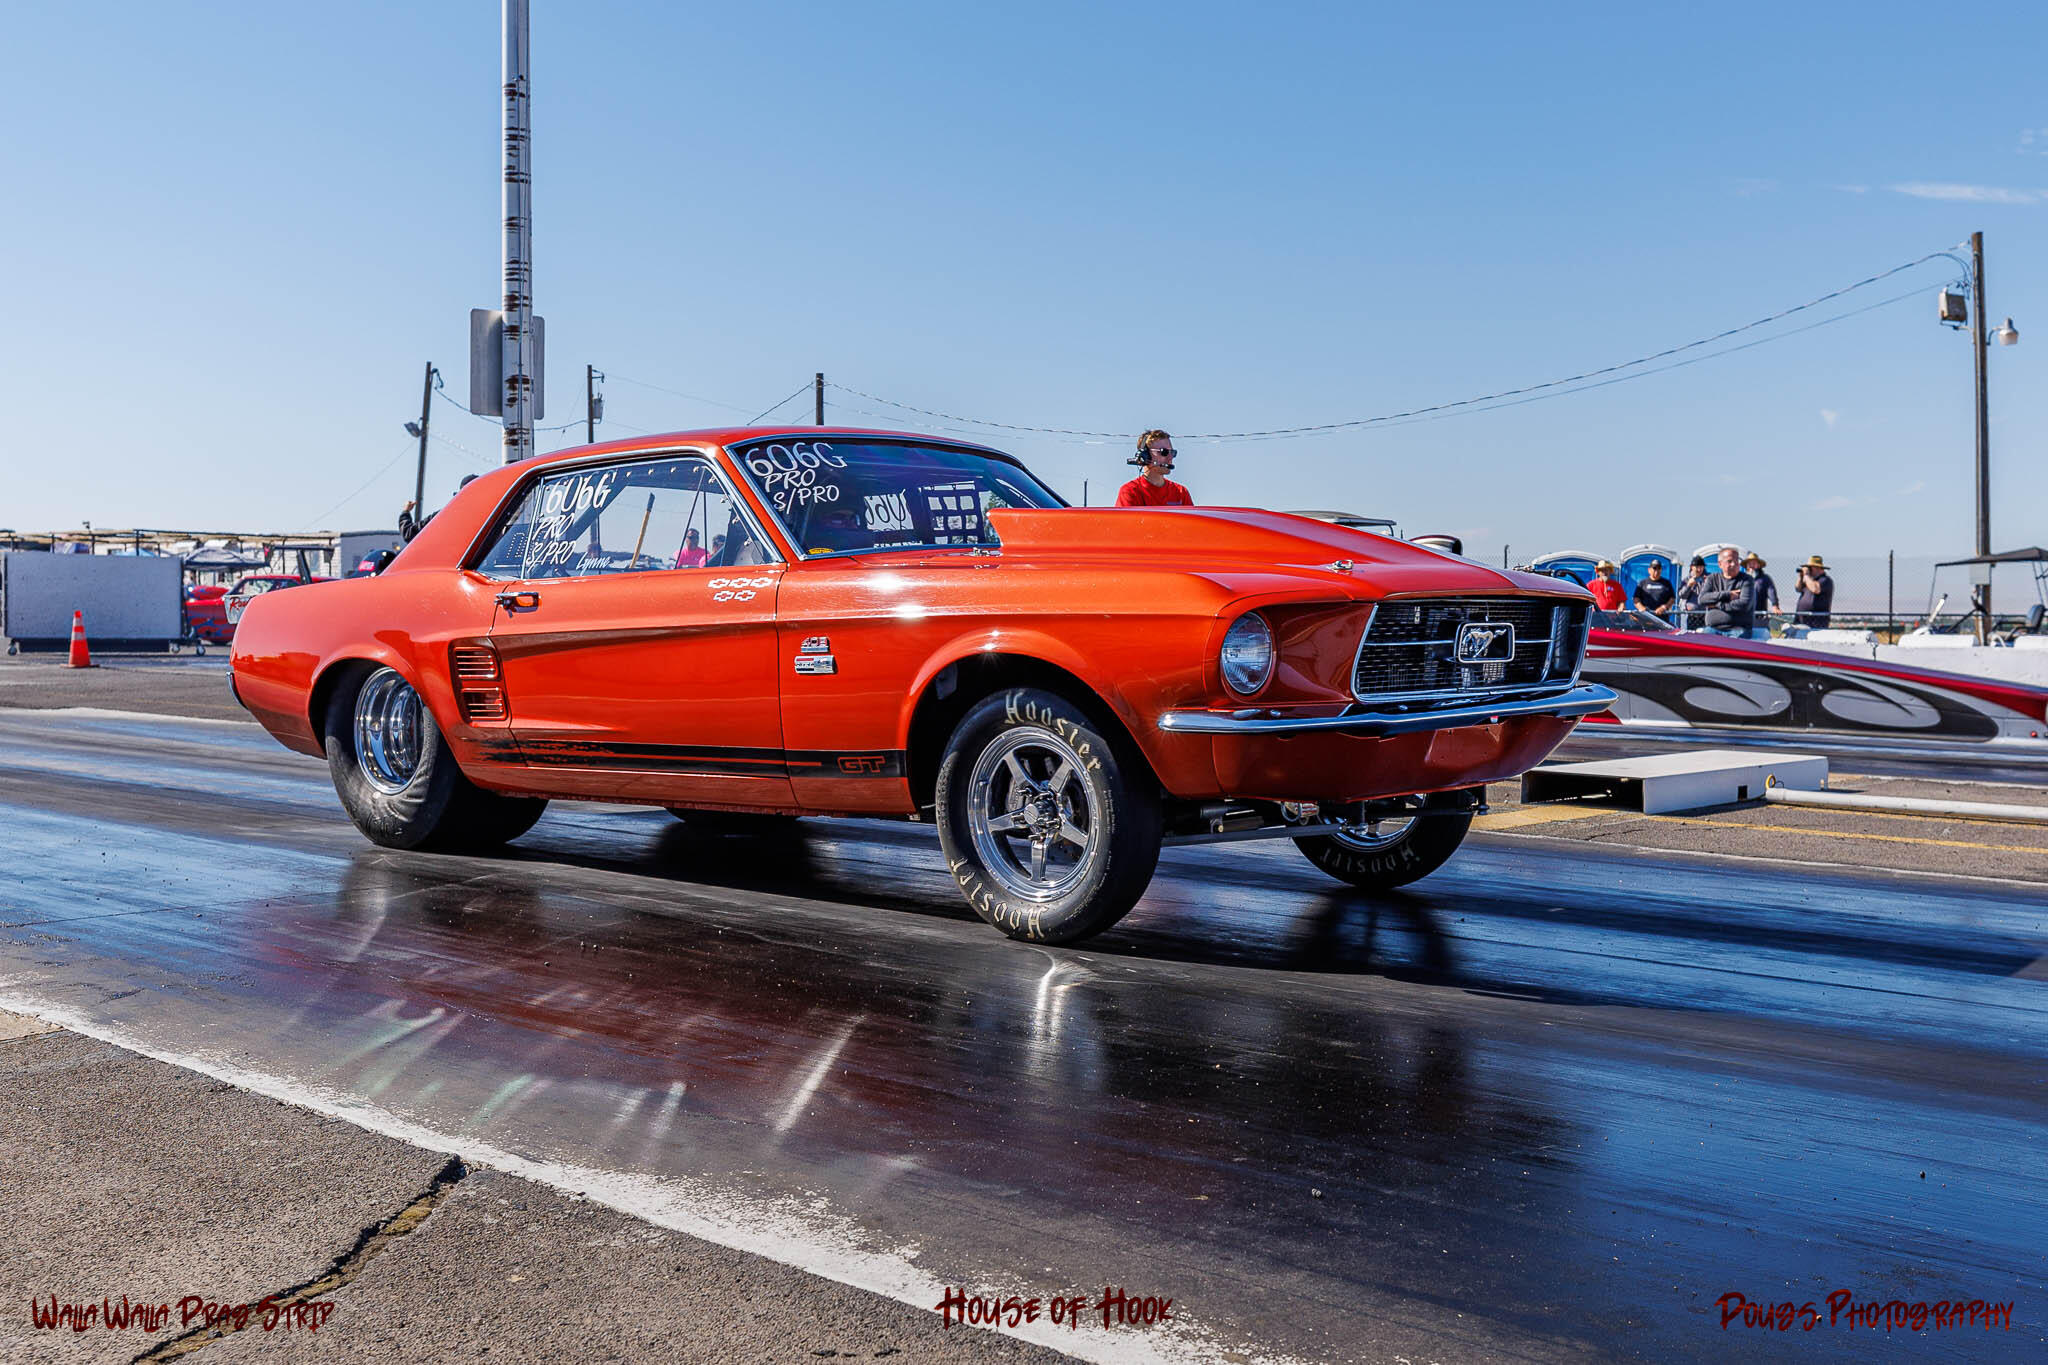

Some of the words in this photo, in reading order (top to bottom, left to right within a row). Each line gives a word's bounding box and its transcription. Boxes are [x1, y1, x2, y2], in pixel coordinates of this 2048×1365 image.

[745, 442, 848, 476] 606G
[545, 473, 612, 514] 606G
[764, 469, 816, 493] PRO
[773, 485, 840, 515] S/PRO
[532, 513, 575, 540] PRO
[526, 541, 577, 574] S/PRO
[837, 756, 886, 774] GT
